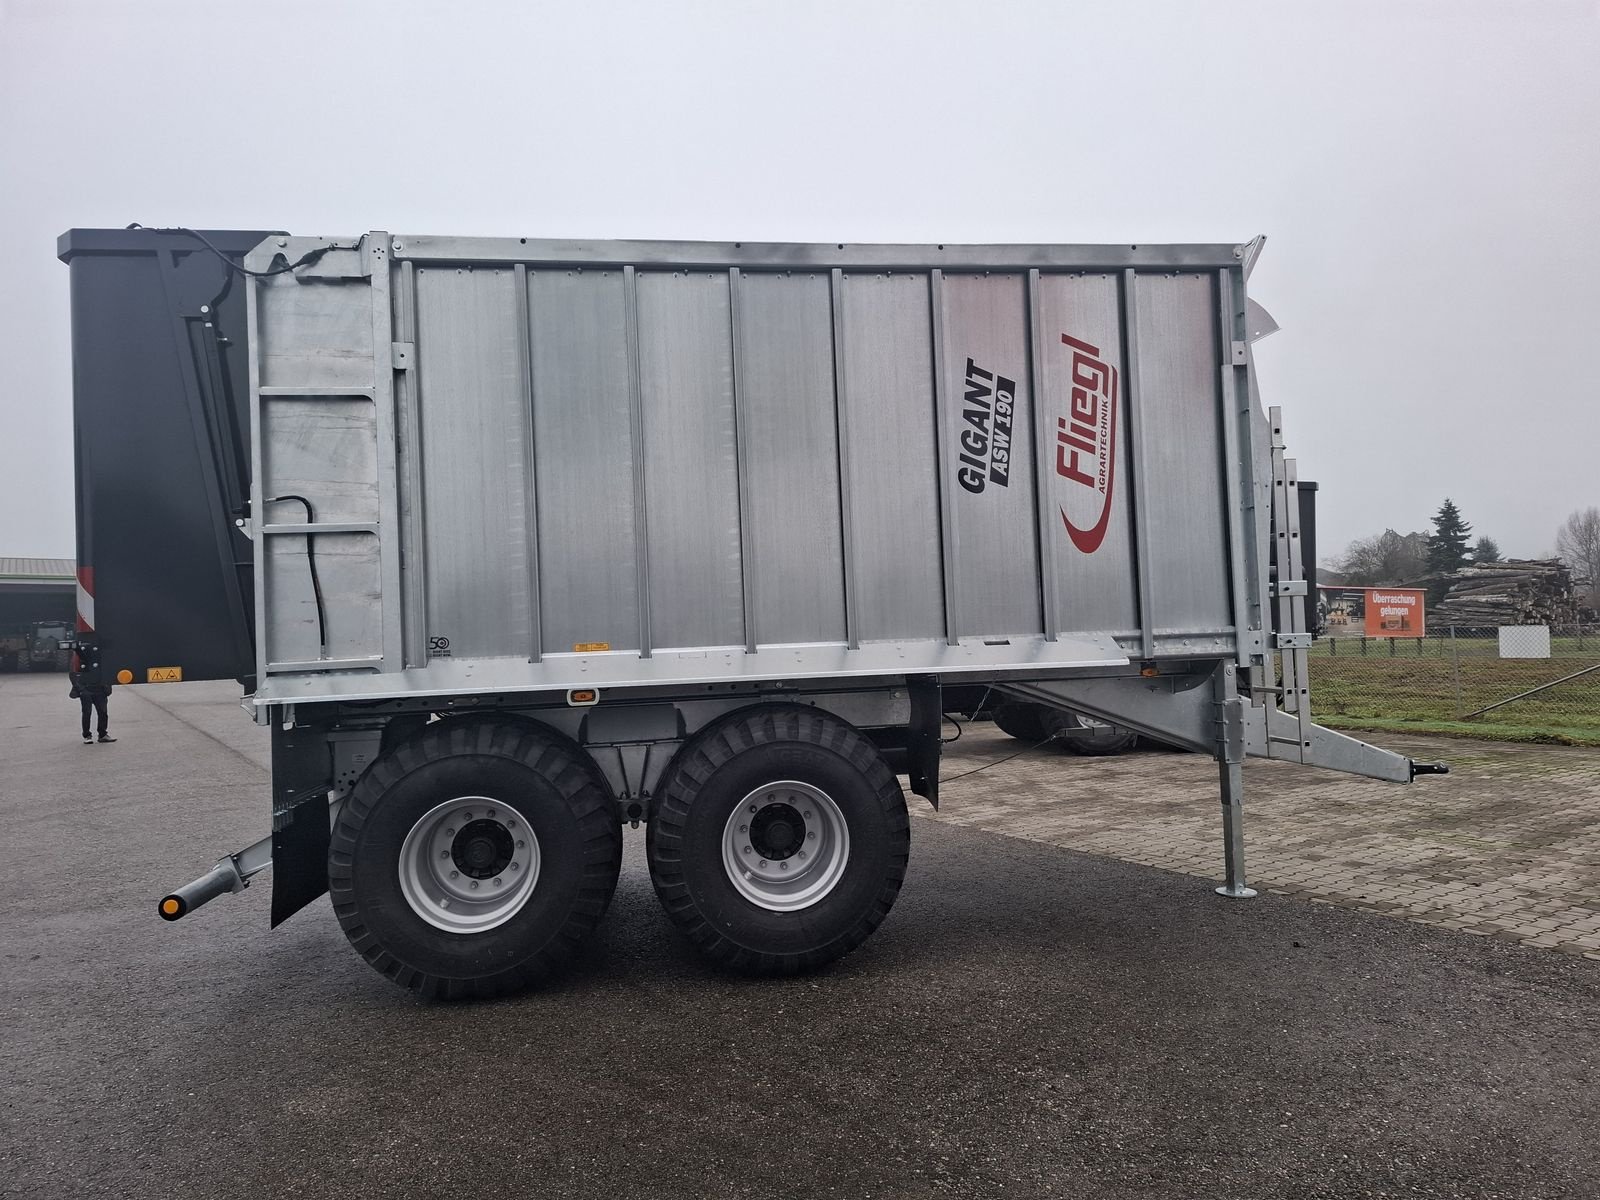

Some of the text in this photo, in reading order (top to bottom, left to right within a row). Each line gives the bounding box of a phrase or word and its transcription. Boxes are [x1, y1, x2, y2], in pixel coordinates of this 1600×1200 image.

[957, 357, 993, 494] GIGANT
[992, 389, 1013, 477] ASW 190
[1057, 333, 1109, 488] Fliegl
[1098, 400, 1109, 495] AGRARTECHNIK
[1372, 591, 1416, 606] Überraschung
[1380, 605, 1409, 617] gelungen
